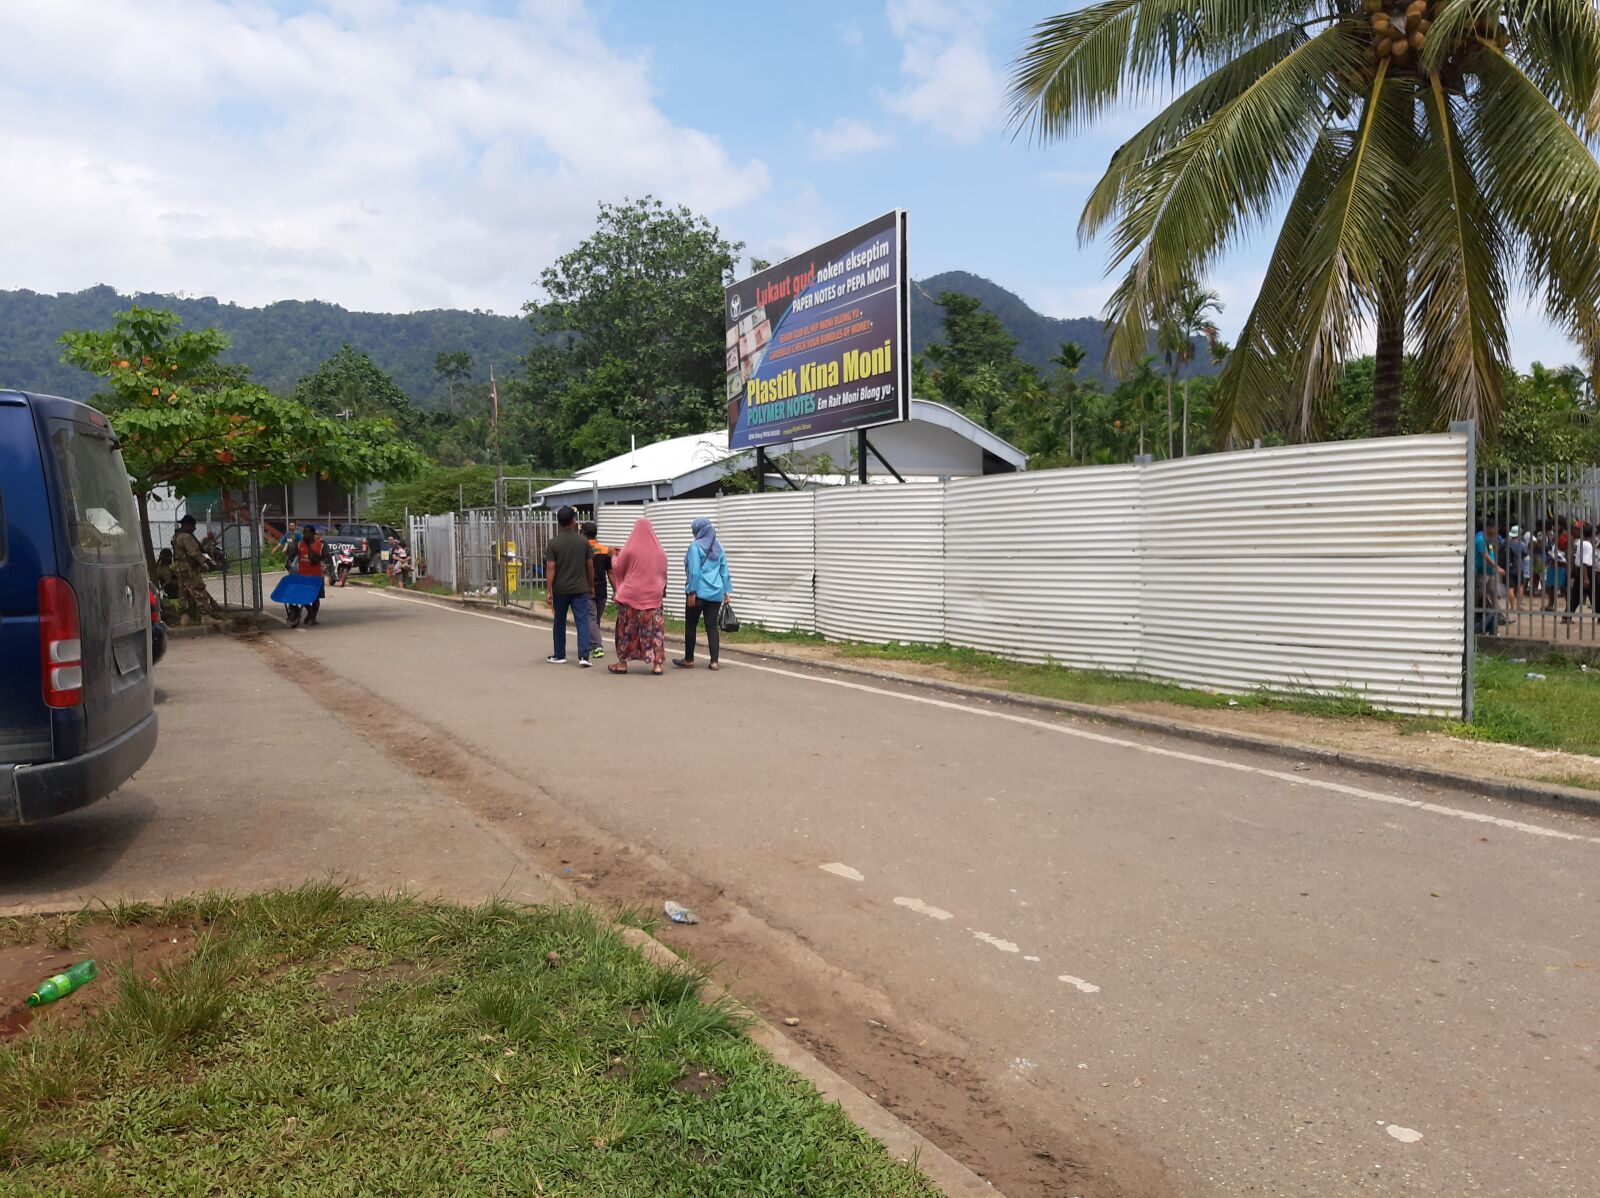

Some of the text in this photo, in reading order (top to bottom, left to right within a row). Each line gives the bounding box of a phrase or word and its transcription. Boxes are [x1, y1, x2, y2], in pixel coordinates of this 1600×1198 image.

[756, 240, 890, 307] Lukaut gud noken ekseptim
[792, 262, 890, 314] PAPER NOTES or PEPA MONI
[747, 339, 892, 407] Plastik Kina Moni
[747, 384, 891, 427] POLYMER NOTES Em Rait Moni Blong yu
